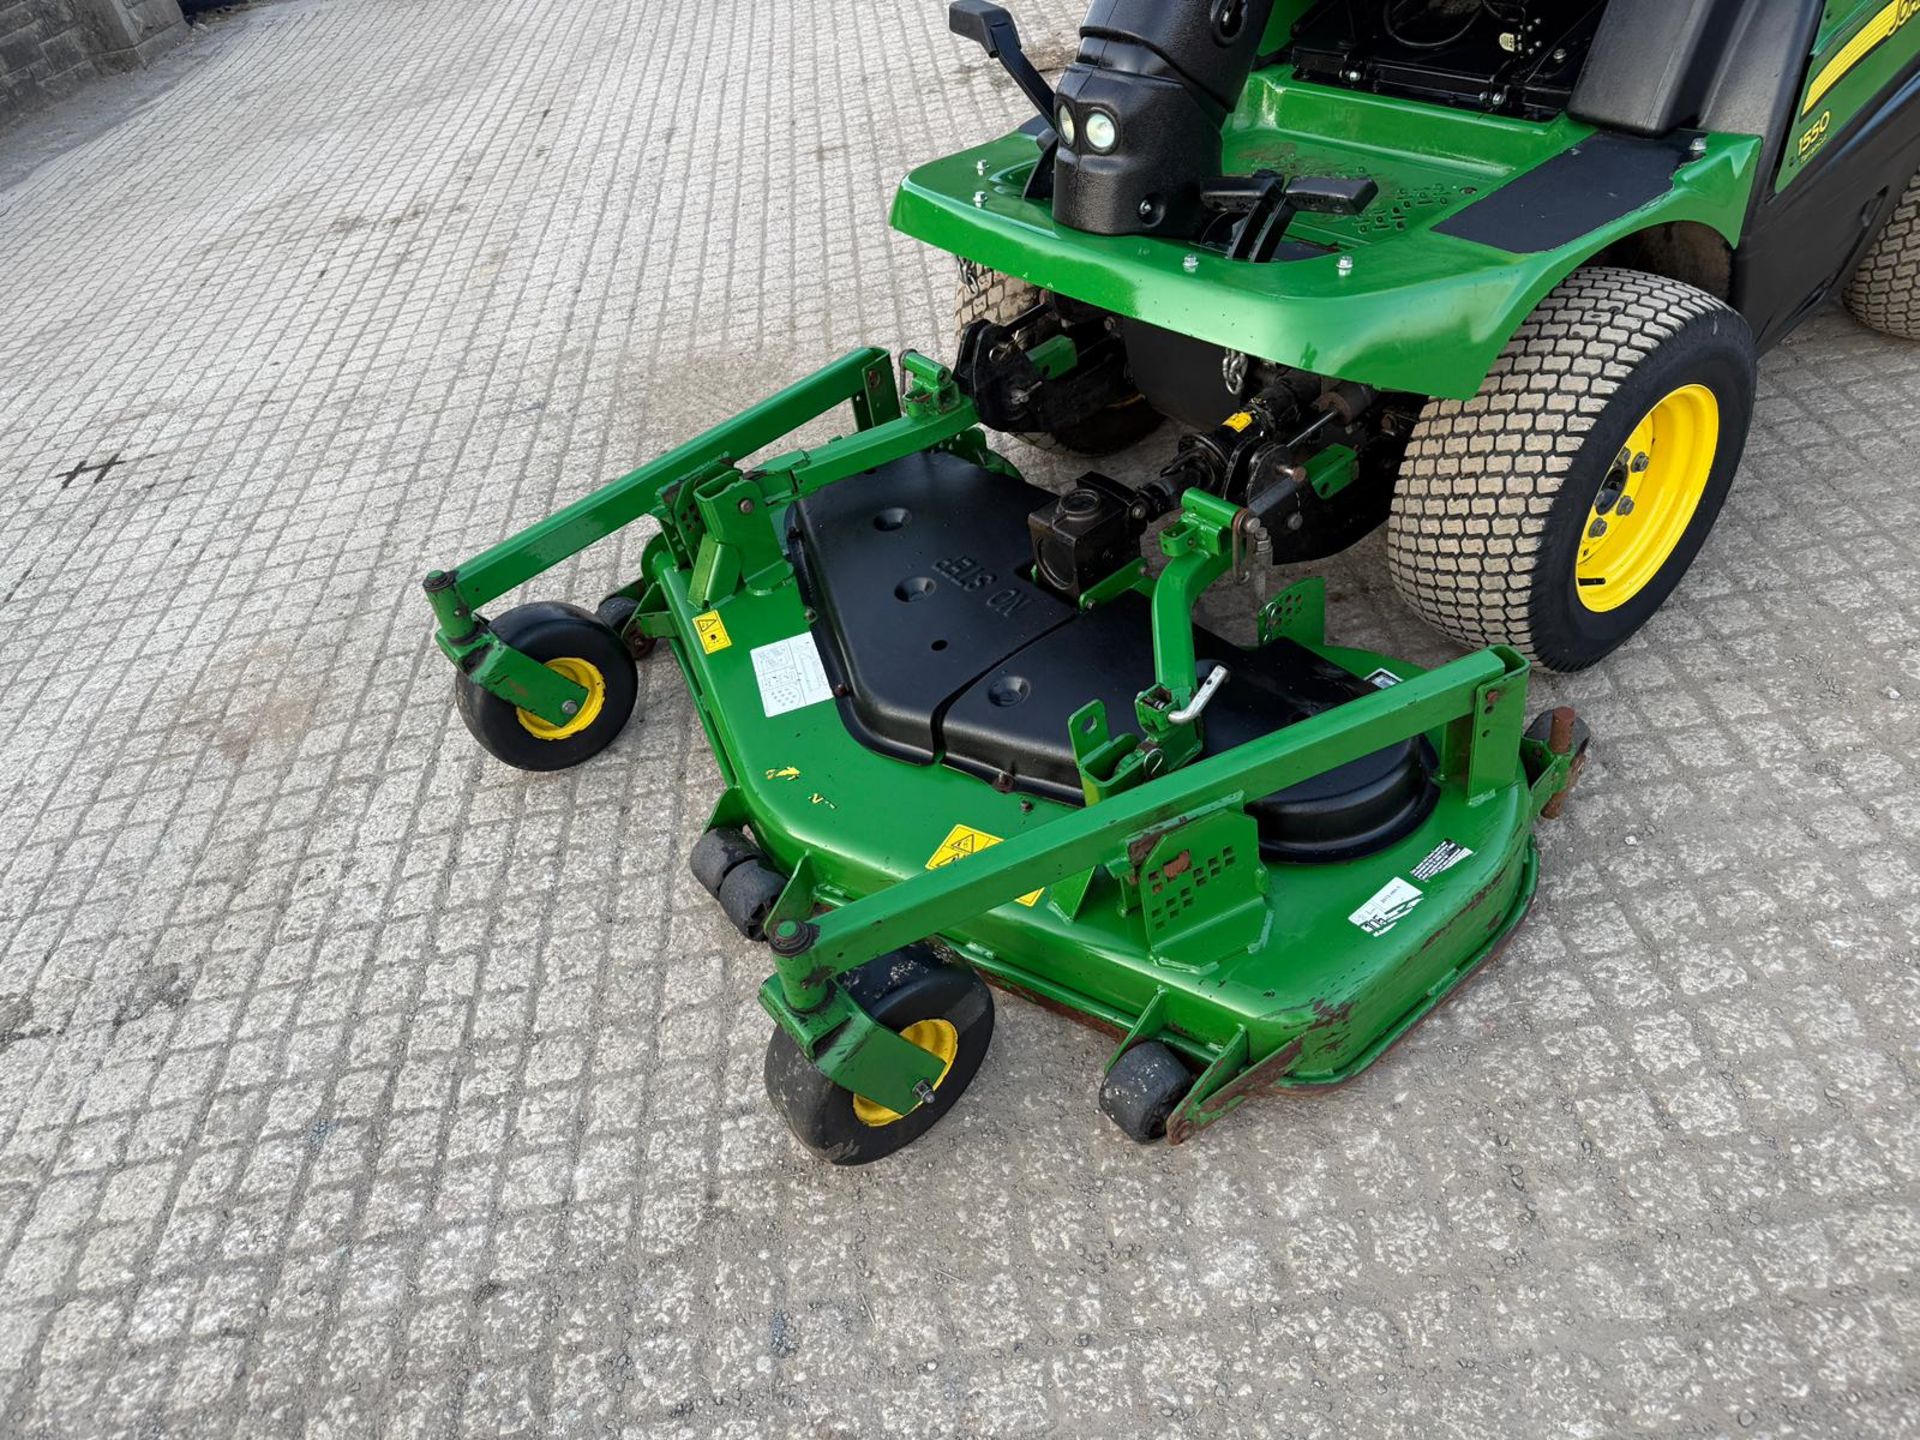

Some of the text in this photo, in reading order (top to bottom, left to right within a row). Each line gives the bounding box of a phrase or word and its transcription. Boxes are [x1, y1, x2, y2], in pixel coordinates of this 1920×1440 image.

[1798, 110, 1830, 156] 1550
[932, 555, 1030, 617] NO STEP
